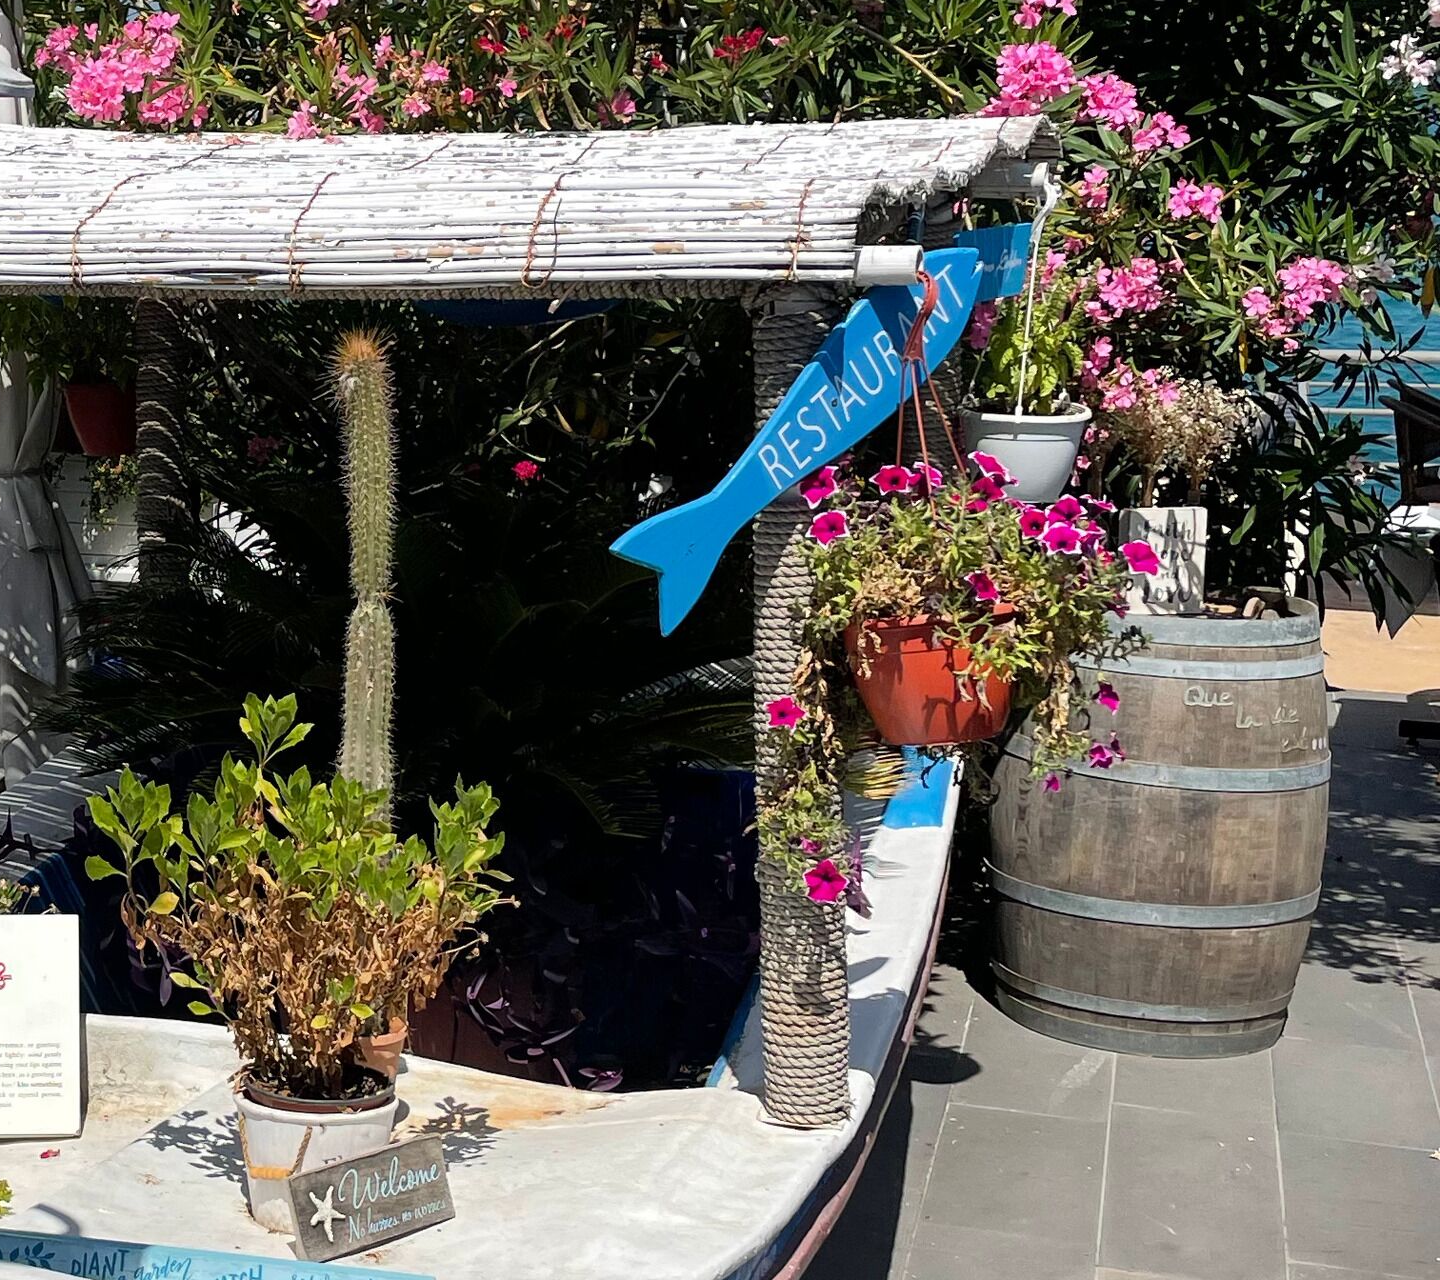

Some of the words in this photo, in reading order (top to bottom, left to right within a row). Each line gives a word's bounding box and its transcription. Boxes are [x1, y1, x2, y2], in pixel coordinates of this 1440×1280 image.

[758, 263, 965, 492] RESTAURANT
[1184, 685, 1234, 707] Que
[337, 1155, 441, 1210] Welcome
[348, 1212, 366, 1243] No
